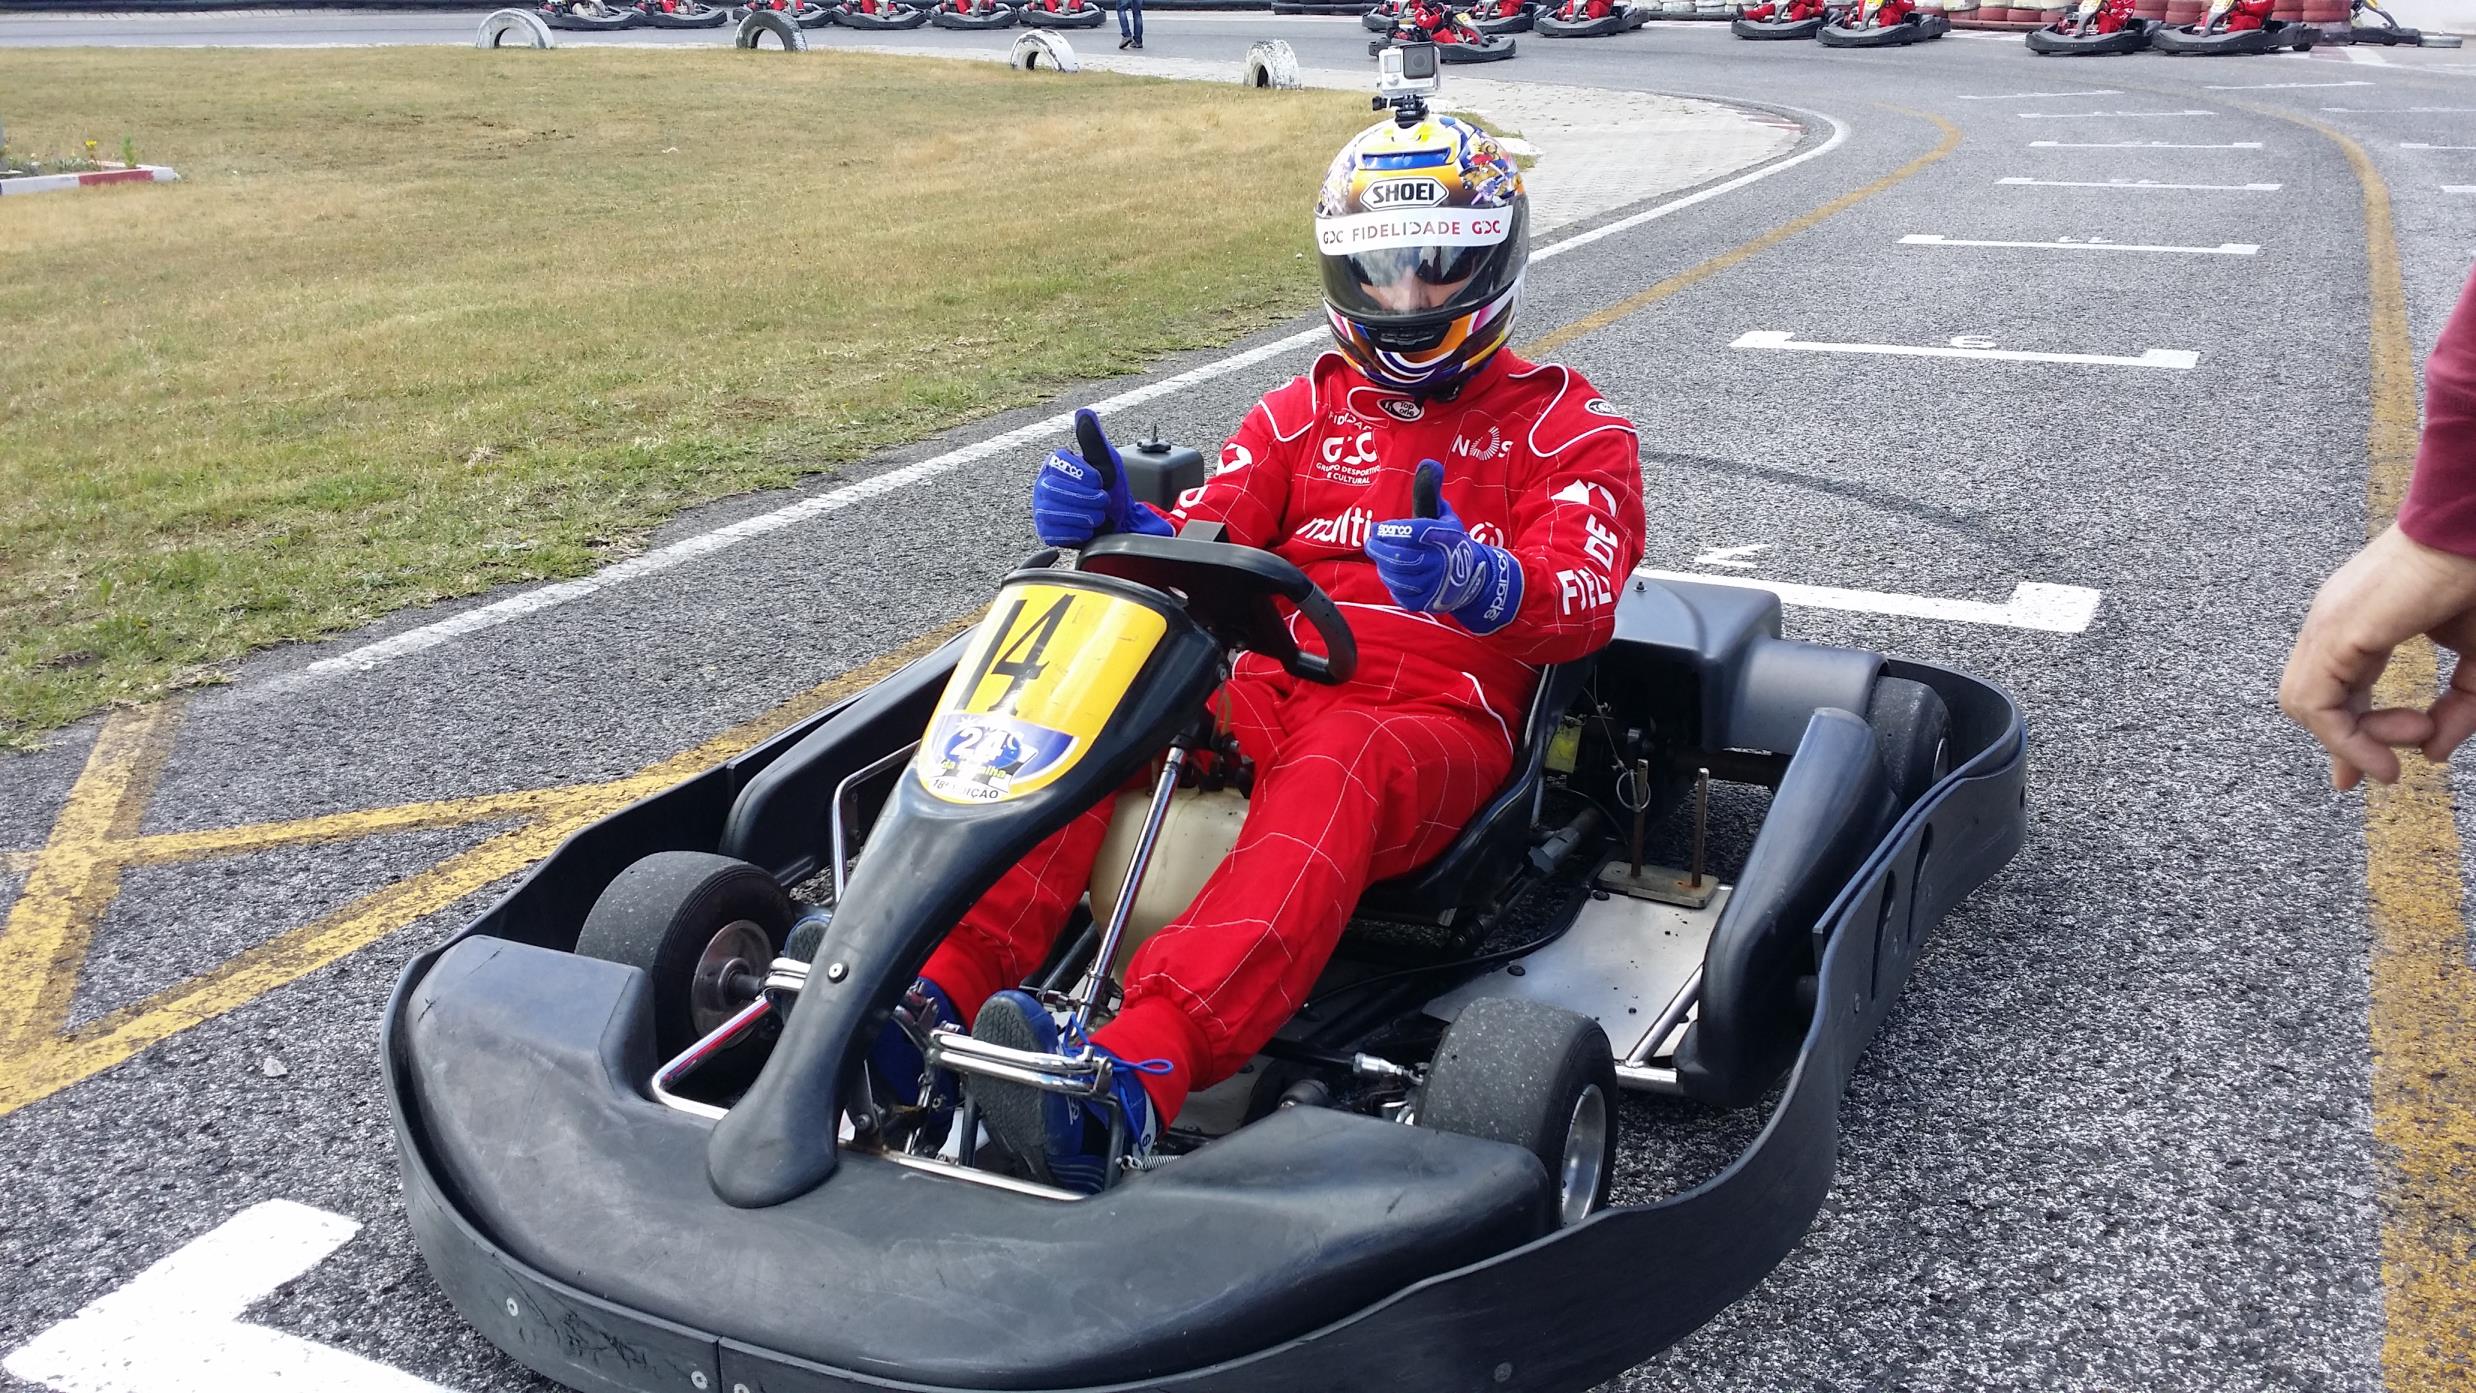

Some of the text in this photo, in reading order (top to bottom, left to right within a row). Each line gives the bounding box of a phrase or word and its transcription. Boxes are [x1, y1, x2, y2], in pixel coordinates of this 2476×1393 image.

[1372, 182, 1435, 203] SHOEI
[1352, 220, 1461, 242] FIDELIDADE
[1399, 407, 1414, 417] one
[1400, 401, 1414, 410] Top
[1451, 425, 1514, 462] NOS
[1316, 462, 1381, 477] GRUPO DESPORTIVO
[1333, 472, 1370, 485] CULTURAL
[1377, 524, 1412, 538] sparco
[1483, 549, 1509, 622] sparco
[954, 593, 1076, 717] 14
